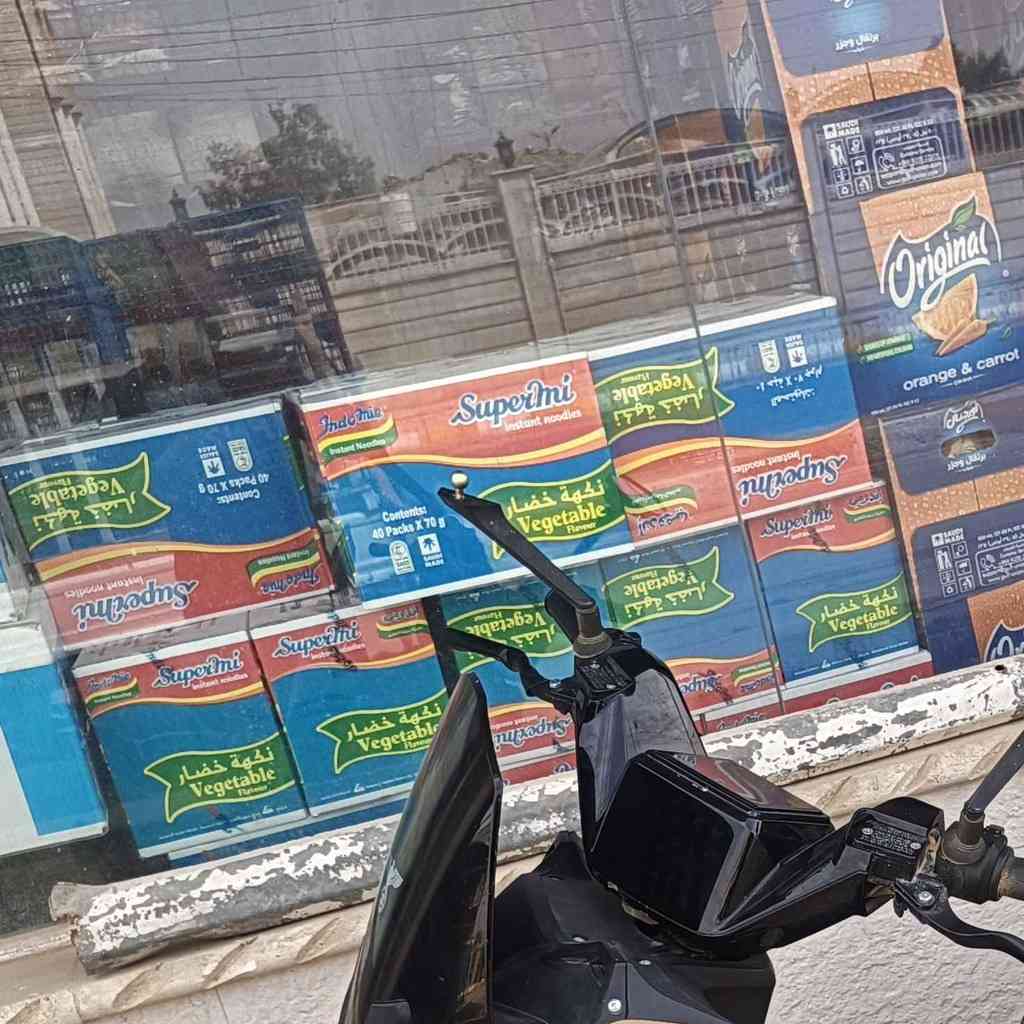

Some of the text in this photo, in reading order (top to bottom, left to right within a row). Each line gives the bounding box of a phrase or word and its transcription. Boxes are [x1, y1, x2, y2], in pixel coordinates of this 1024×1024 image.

[889, 221, 991, 312] Original
[903, 348, 1020, 392] orange & carrot
[612, 372, 696, 402] Vegetable
[31, 476, 126, 510] Vegetable
[217, 488, 262, 505] Contents:
[230, 475, 257, 488] Packs
[382, 506, 428, 523] Contents:
[506, 479, 606, 521] نكهة خضار
[372, 526, 384, 540] 40
[385, 522, 415, 537] Packs
[517, 502, 607, 535] Vegetable
[864, 586, 900, 608] نكهة
[828, 604, 900, 633] Vegetable
[400, 704, 443, 725] نكهة
[178, 746, 275, 786] نكهة خضار
[189, 766, 277, 799] Vegetable
